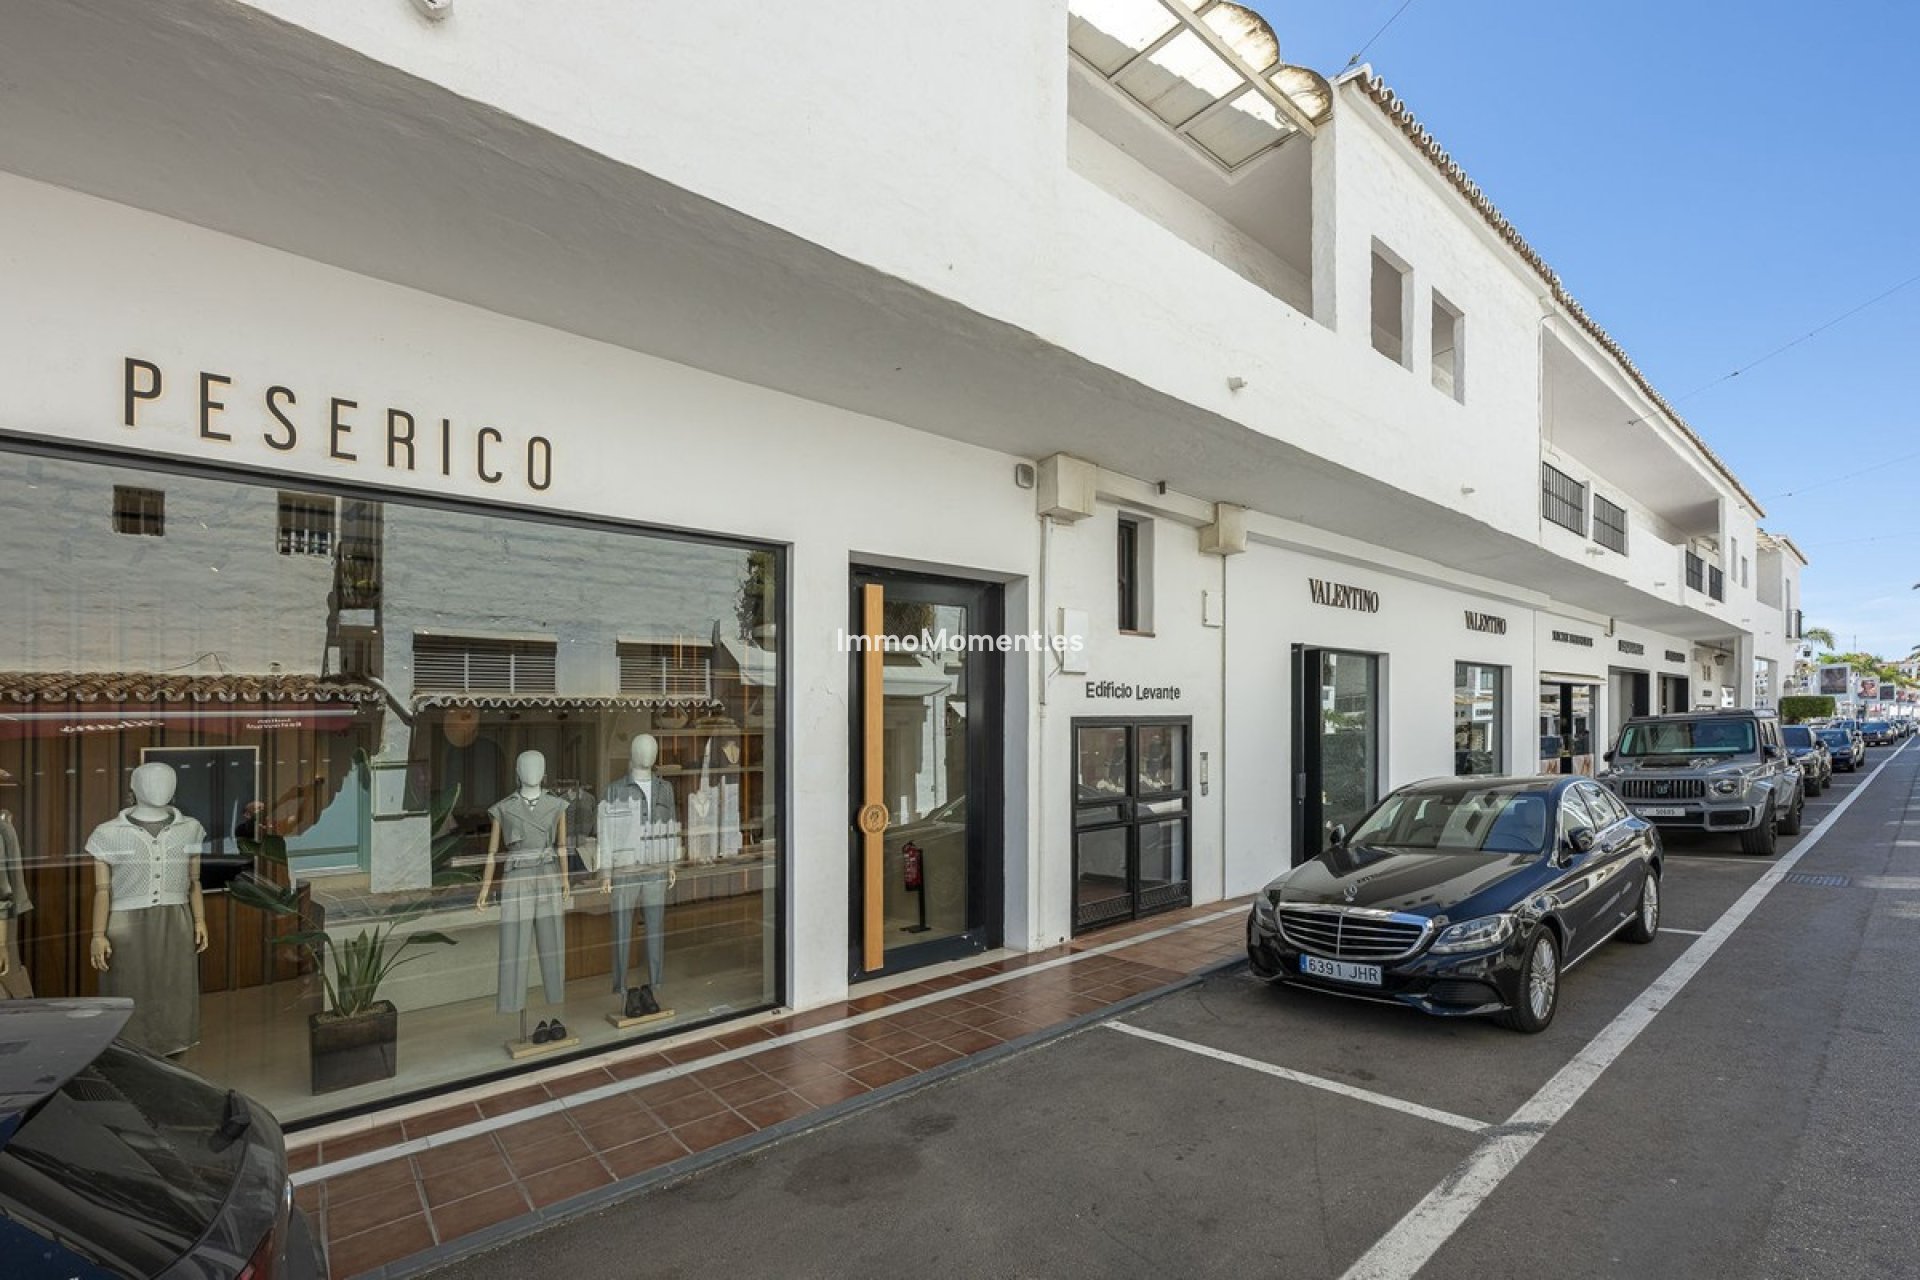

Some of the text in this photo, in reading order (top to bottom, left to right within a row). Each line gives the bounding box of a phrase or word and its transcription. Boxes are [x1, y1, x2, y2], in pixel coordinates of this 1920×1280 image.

[124, 356, 552, 491] PESERICO
[1308, 577, 1380, 614] VALENTINO
[1463, 609, 1507, 636] VALENTINO
[1085, 680, 1181, 701] Edificio Levante
[1308, 958, 1379, 982] 6391 JHR
